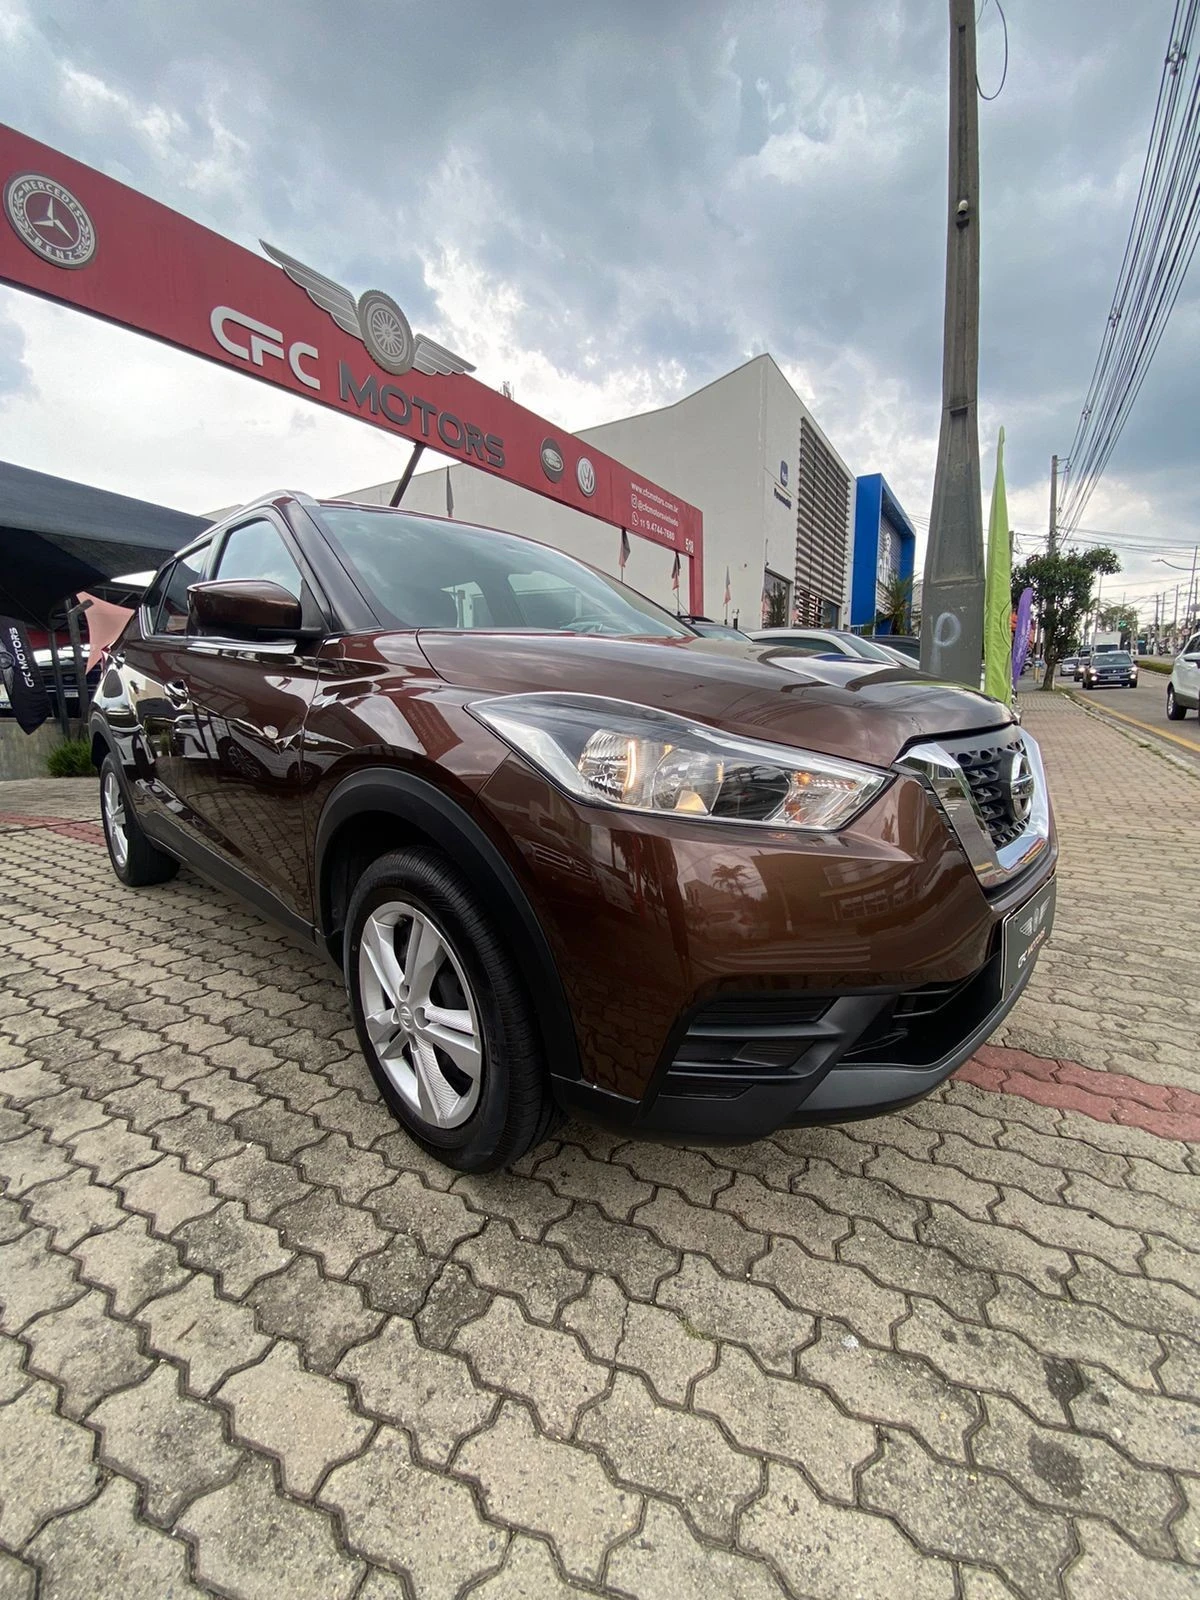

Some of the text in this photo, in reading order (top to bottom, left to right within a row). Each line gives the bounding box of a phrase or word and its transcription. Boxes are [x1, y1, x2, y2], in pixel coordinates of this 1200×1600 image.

[21, 180, 82, 218] MERCEDES
[34, 237, 75, 260] BENZ
[210, 305, 506, 468] CFC MOTORS
[8, 626, 35, 688] CFC MOTORS
